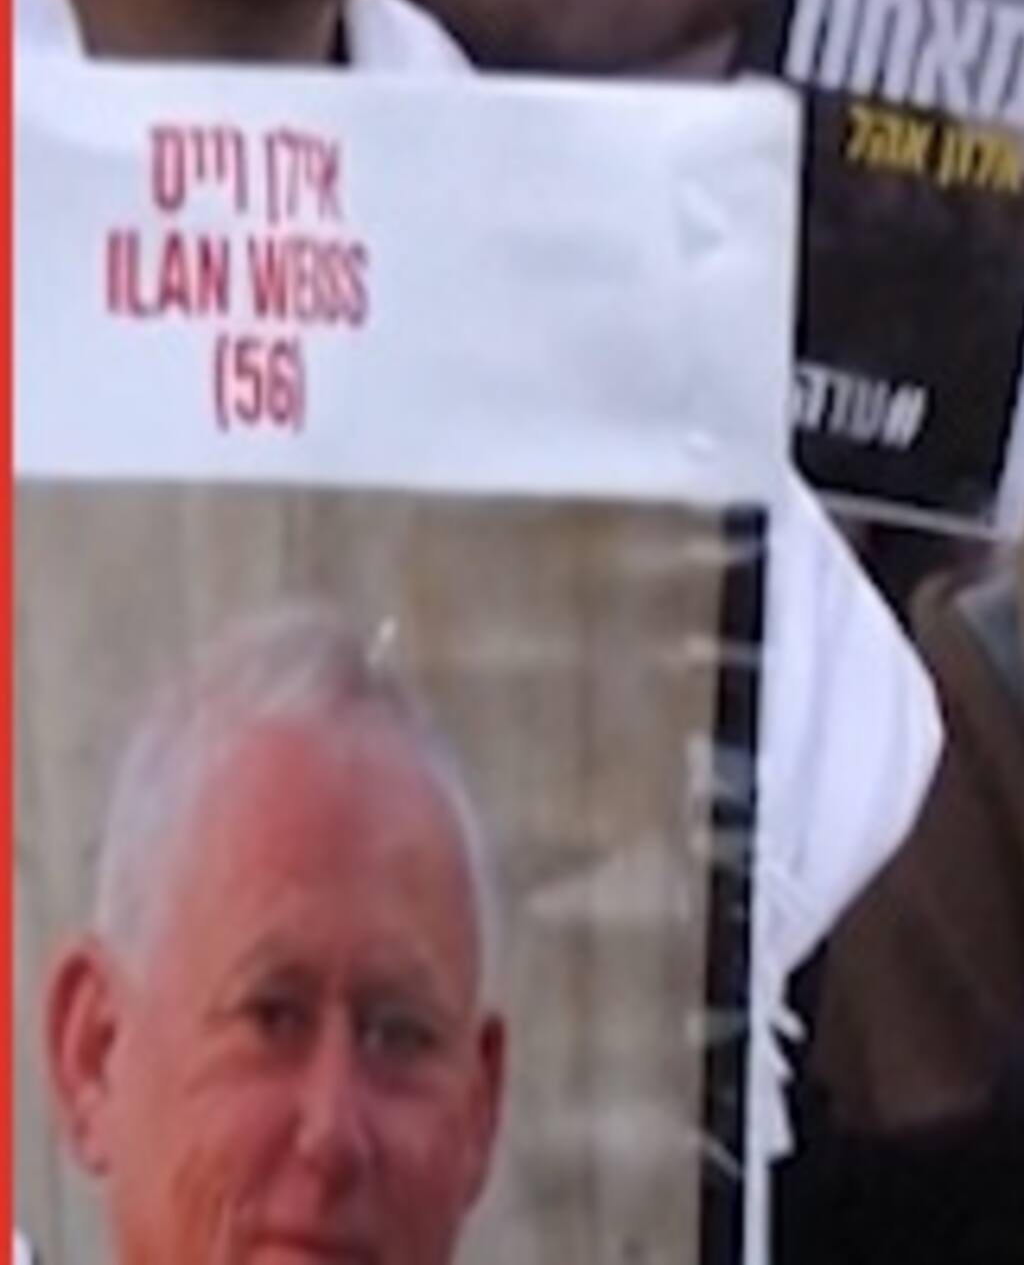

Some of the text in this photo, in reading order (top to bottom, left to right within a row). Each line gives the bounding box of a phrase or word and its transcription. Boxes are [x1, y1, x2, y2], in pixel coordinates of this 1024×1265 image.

[150, 124, 342, 224] אילן וייס
[106, 229, 230, 320] ILAN
[214, 331, 306, 435] (56)
